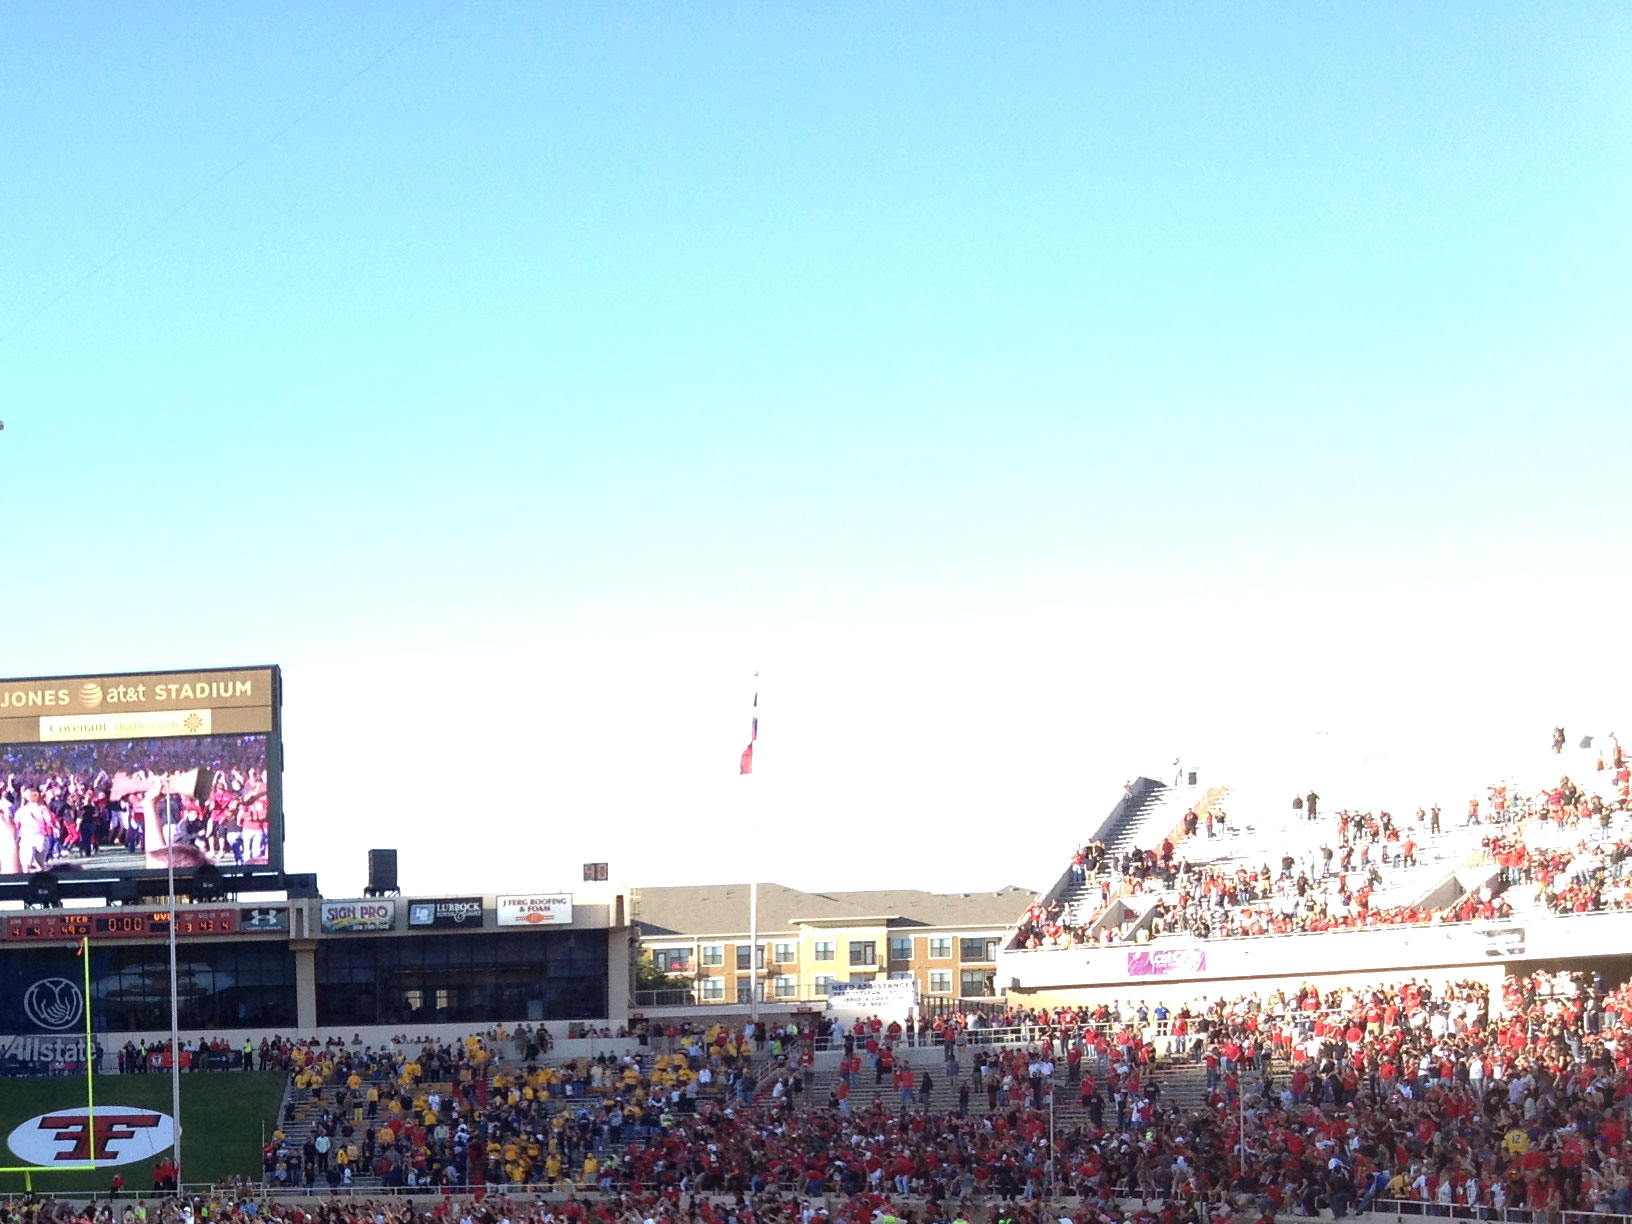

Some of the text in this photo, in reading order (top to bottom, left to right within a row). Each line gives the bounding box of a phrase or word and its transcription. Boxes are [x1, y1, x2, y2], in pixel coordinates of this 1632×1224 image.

[0, 680, 252, 708] JONES at&t STADIUM
[437, 902, 481, 911] LUBBOCK
[530, 898, 567, 906] ROOFING
[327, 905, 388, 921] SIGN PRO
[4, 1035, 97, 1062] Allstate
[1512, 1134, 1521, 1145] 12
